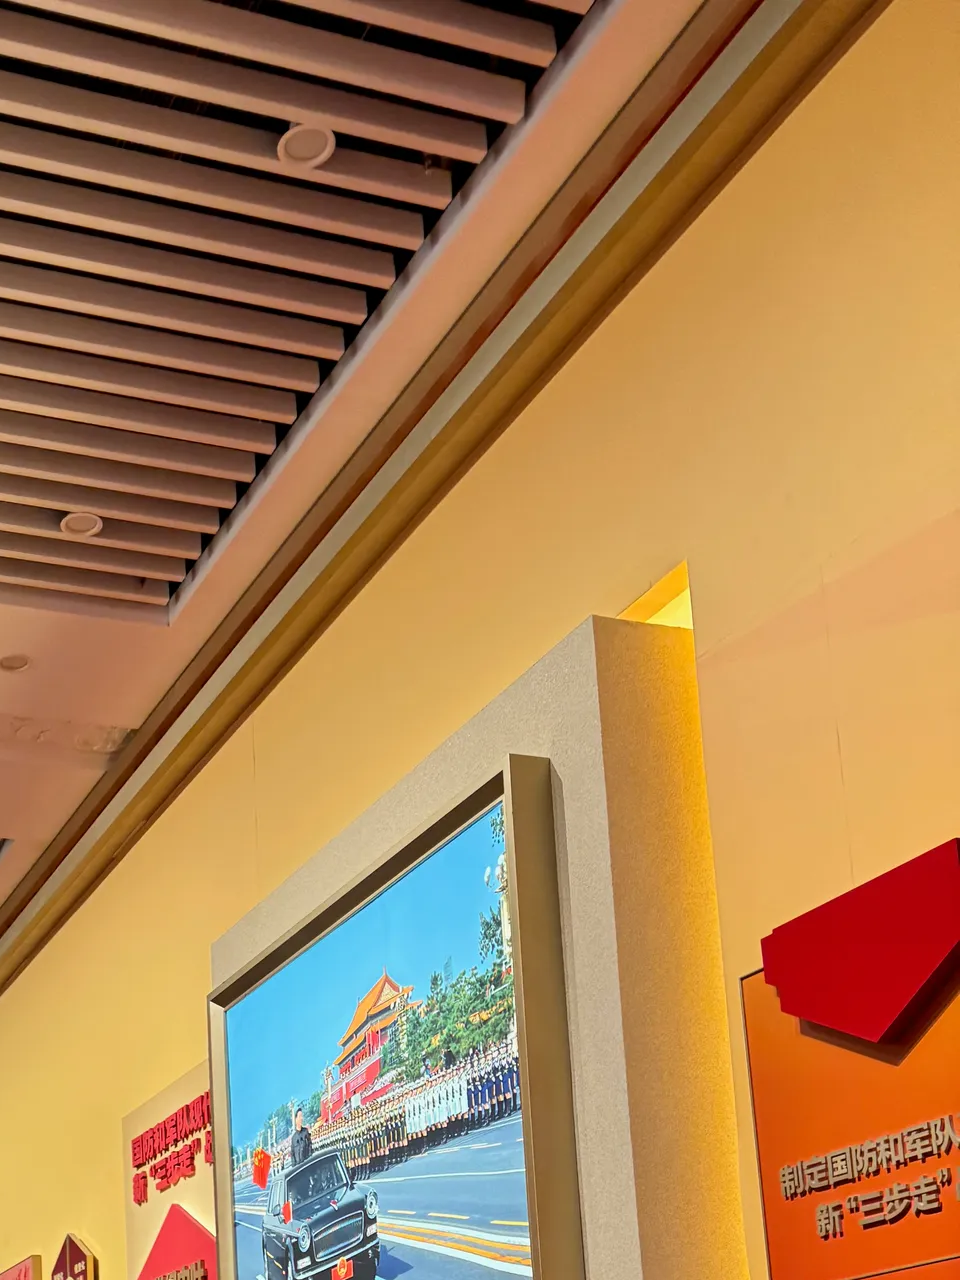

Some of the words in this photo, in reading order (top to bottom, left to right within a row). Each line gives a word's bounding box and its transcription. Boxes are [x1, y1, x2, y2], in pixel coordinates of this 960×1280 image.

[779, 1113, 960, 1199] 制定国防和军队
[816, 1166, 960, 1239] 新“三步走”
